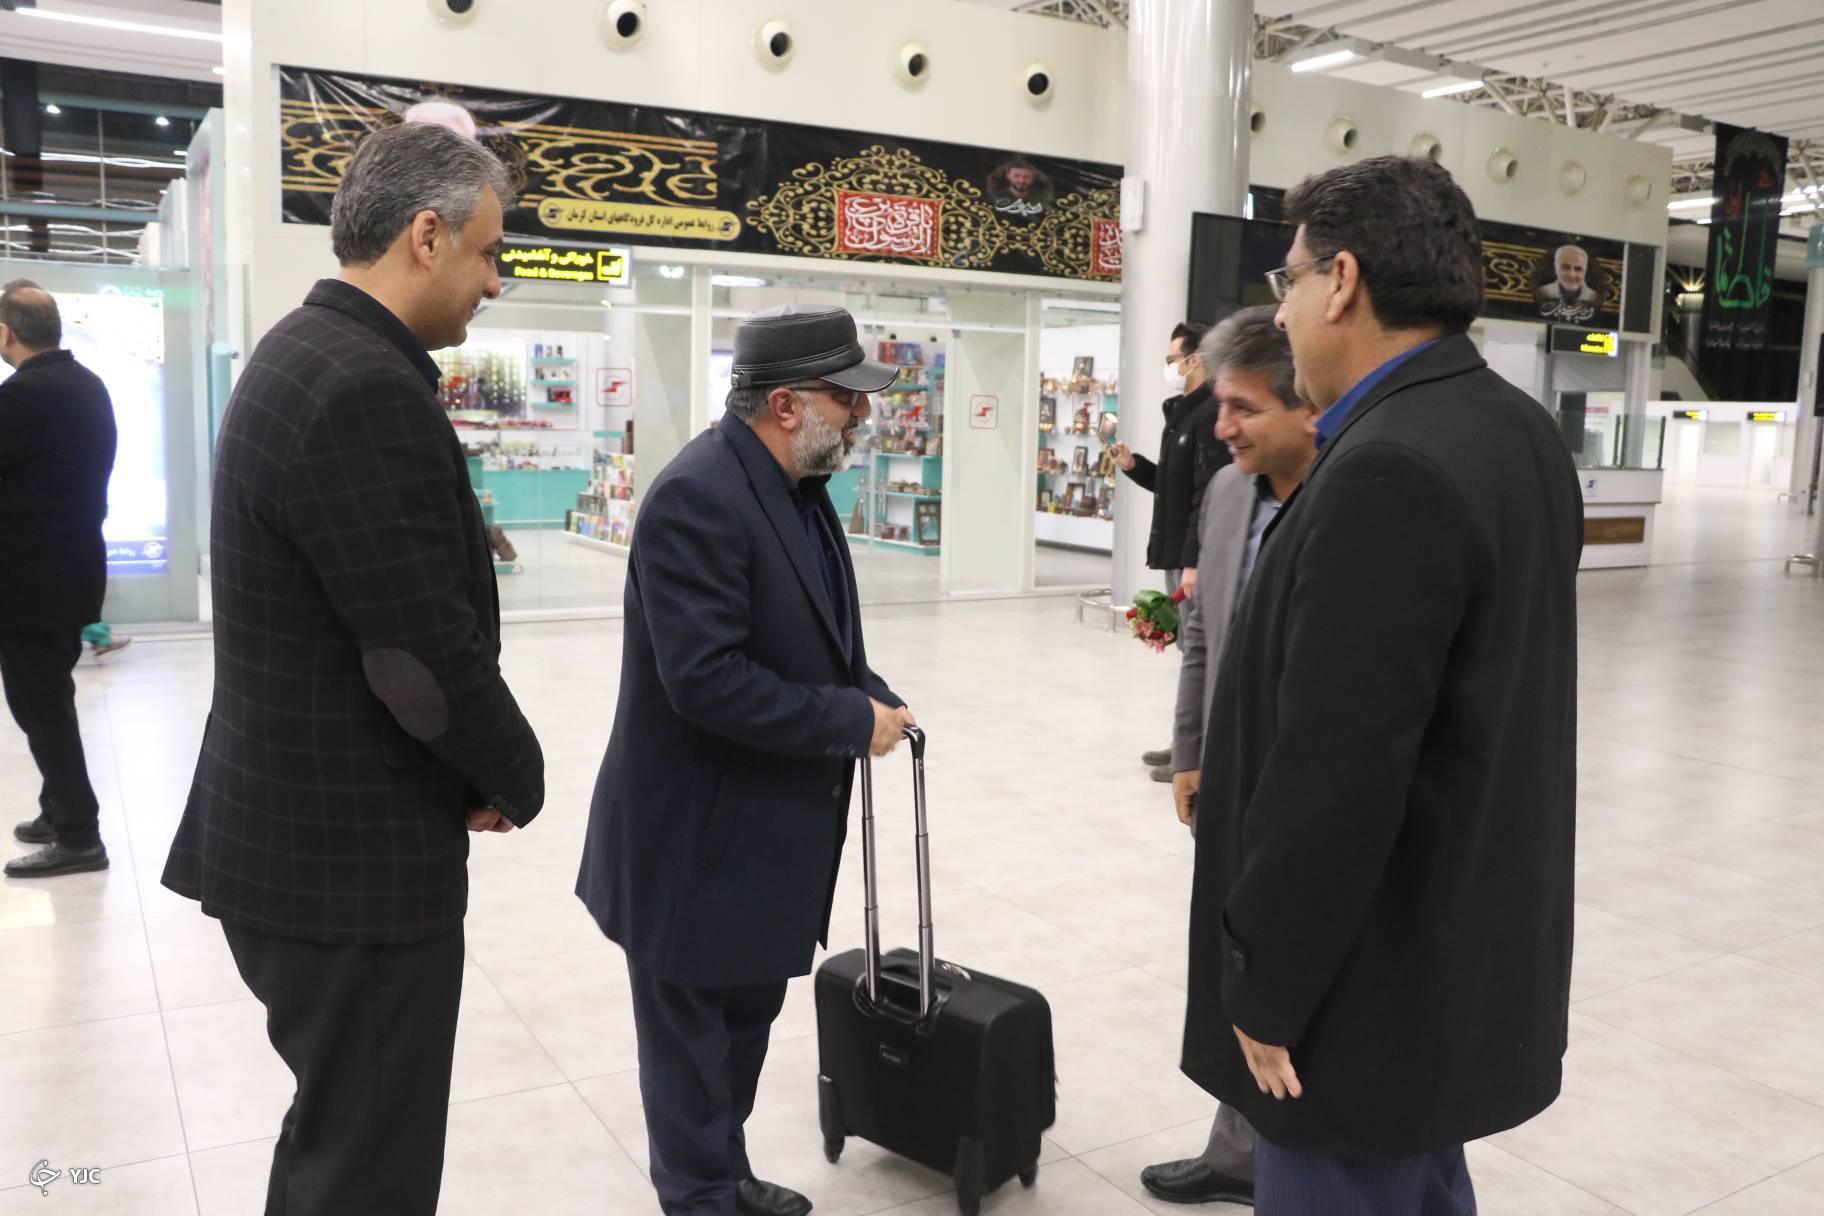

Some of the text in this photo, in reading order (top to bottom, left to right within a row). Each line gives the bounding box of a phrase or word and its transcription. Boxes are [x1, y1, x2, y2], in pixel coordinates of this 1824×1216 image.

[566, 208, 587, 223] کرمان
[588, 209, 607, 224] استان
[646, 213, 656, 228] کل
[657, 214, 673, 229] اداره
[673, 219, 695, 231] عمومی
[697, 217, 714, 232] روابط
[549, 252, 559, 265] و
[514, 265, 539, 278] Food
[539, 266, 548, 278] &
